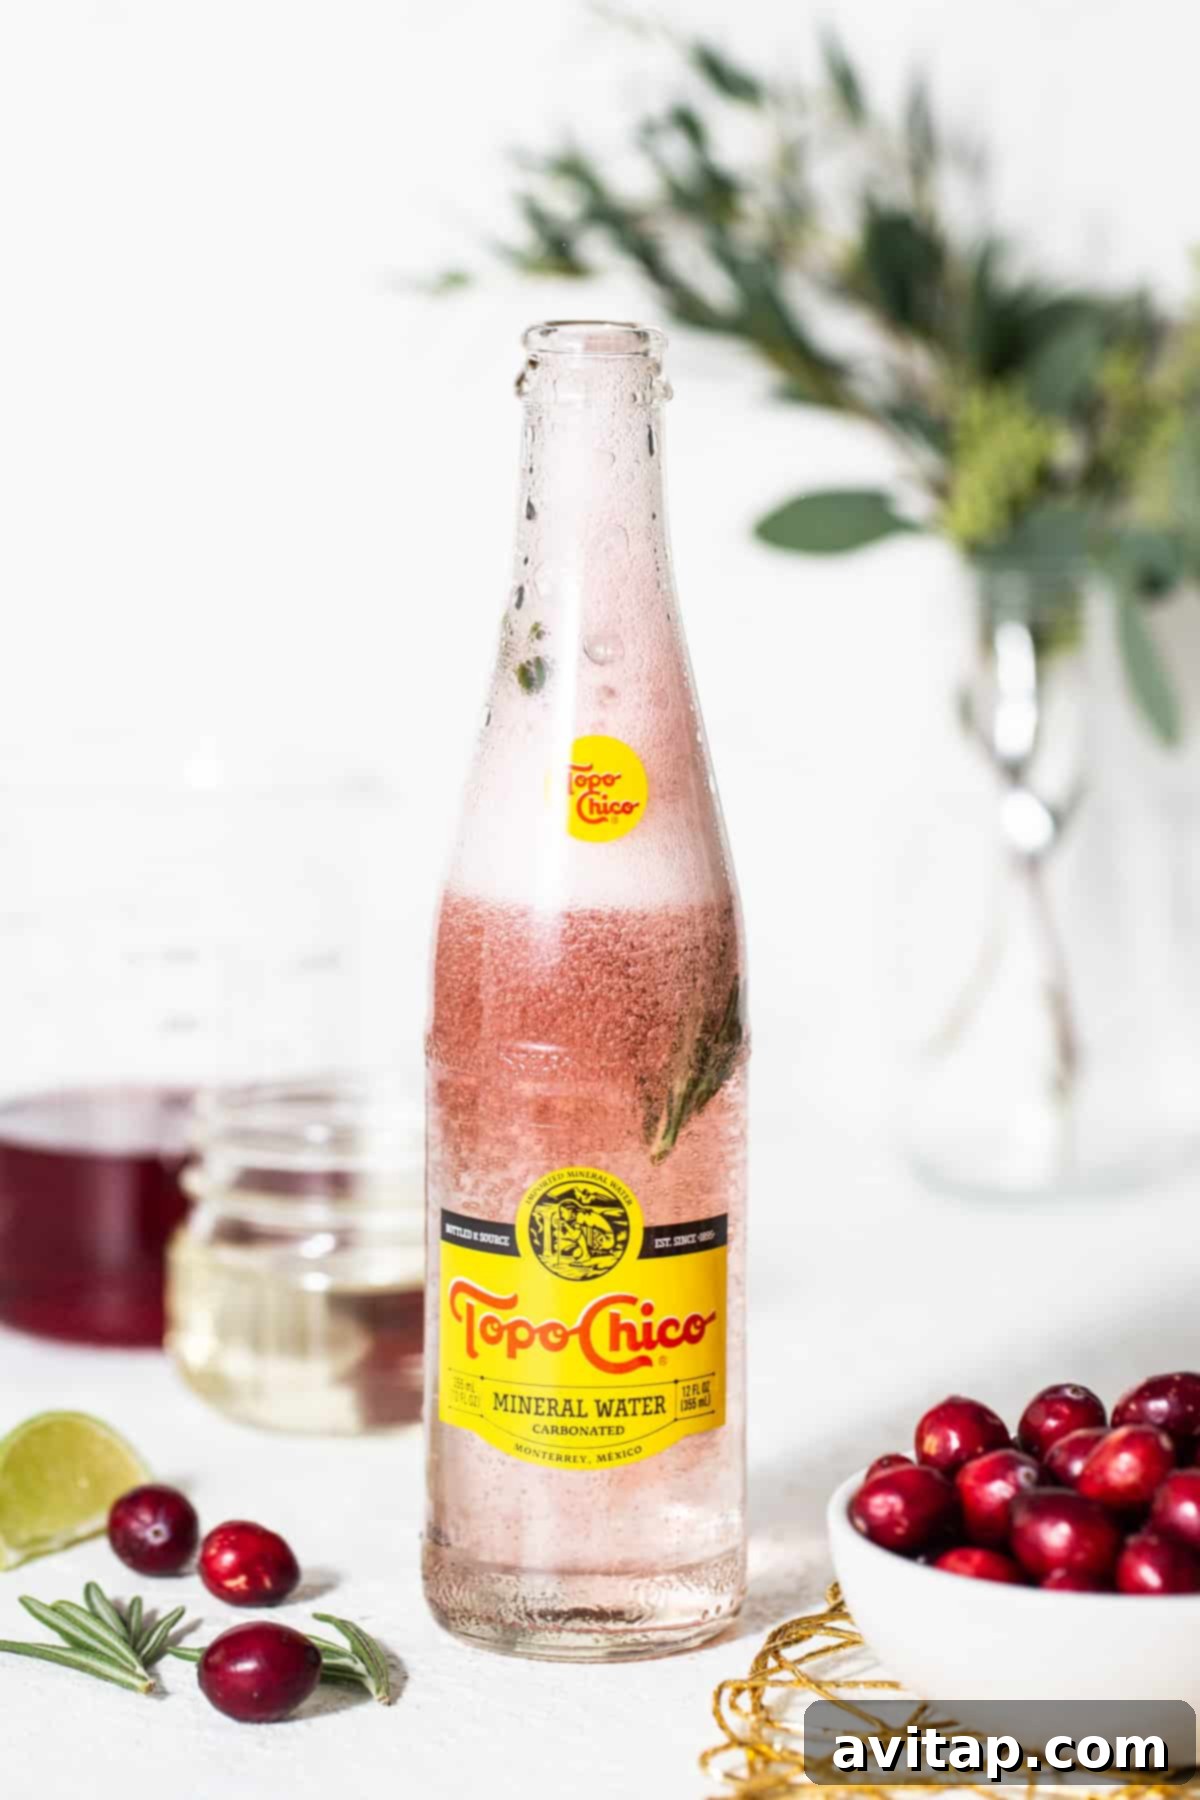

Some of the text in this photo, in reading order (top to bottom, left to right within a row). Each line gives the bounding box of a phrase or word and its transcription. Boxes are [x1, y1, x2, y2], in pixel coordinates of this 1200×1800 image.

[567, 763, 622, 796] Topo
[576, 791, 640, 825] Chico
[566, 1170, 608, 1184] MINERAL
[609, 1180, 633, 1207] WATER
[479, 1232, 511, 1247] SOURCE
[654, 1236, 672, 1249] EST.
[673, 1233, 697, 1247] SINCE
[449, 1278, 717, 1375] Topo Chico
[492, 1392, 667, 1418] MINERAL WATER
[532, 1423, 625, 1437] CARBONATED
[514, 1443, 592, 1465] MONTERREY,
